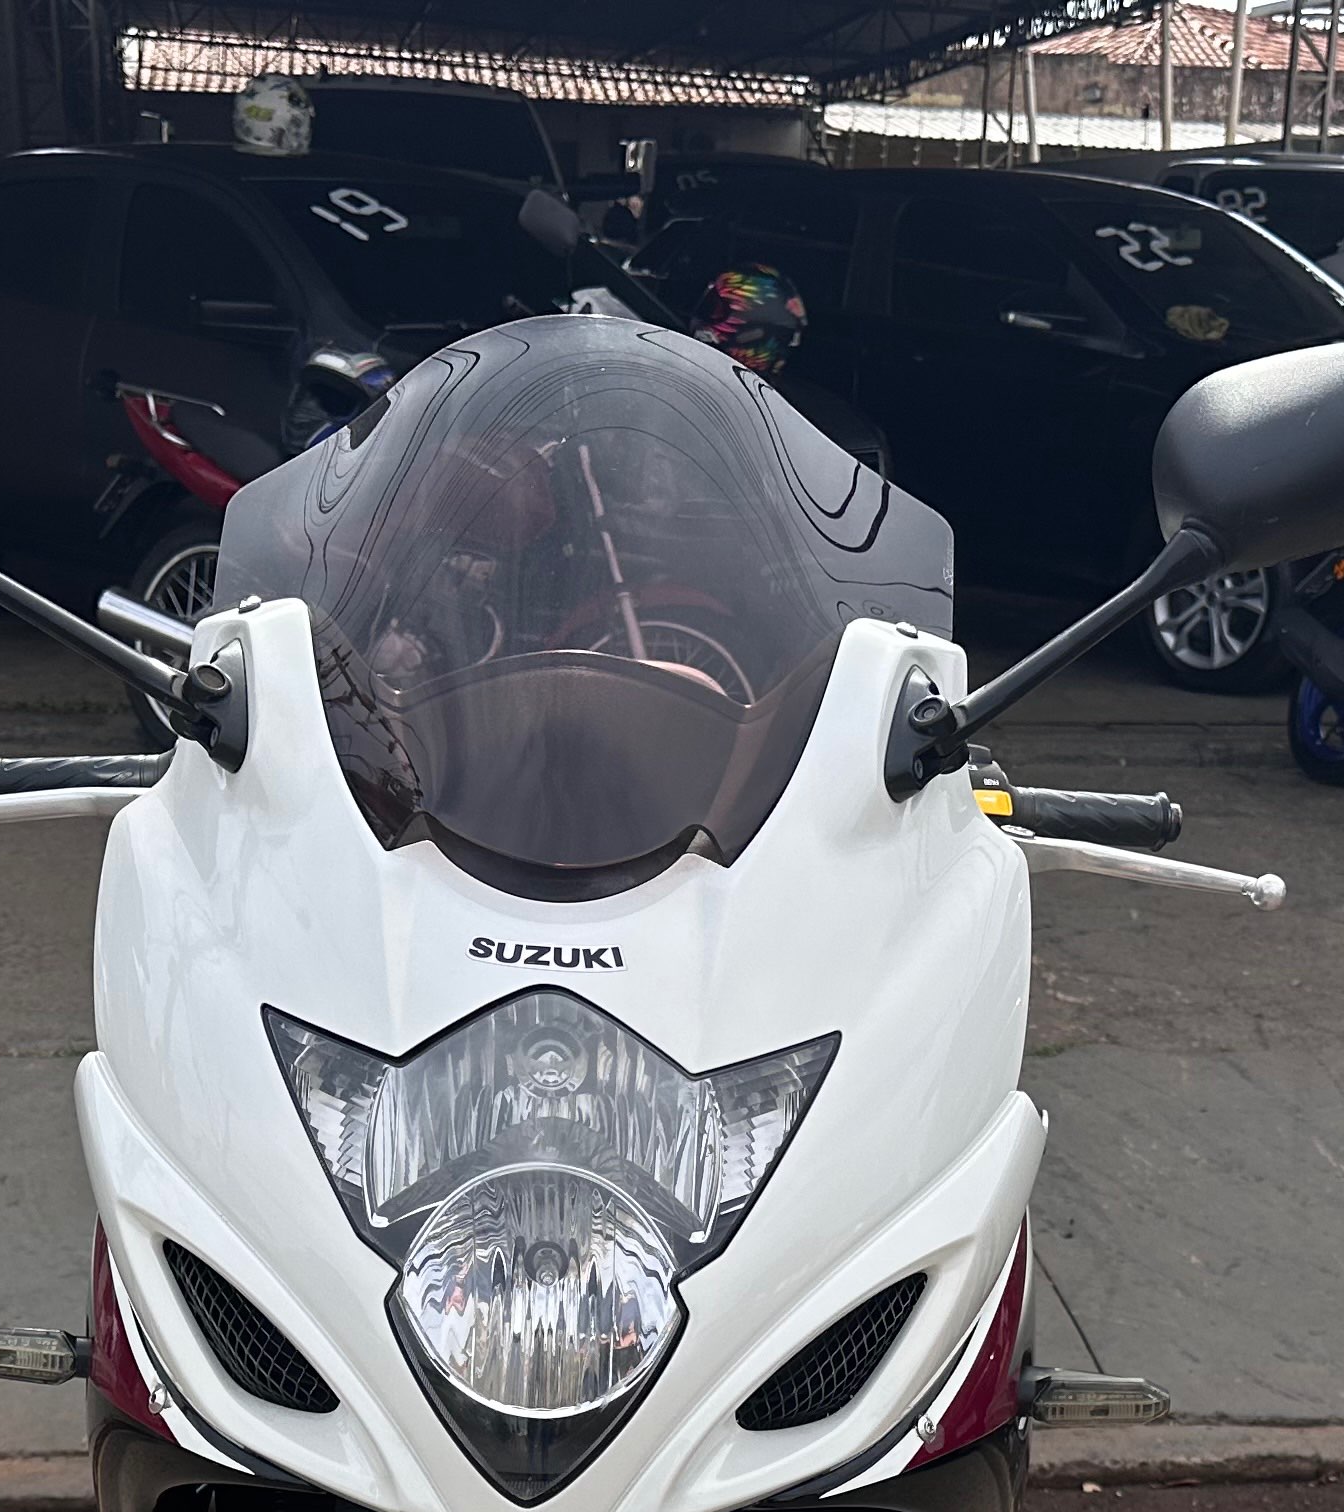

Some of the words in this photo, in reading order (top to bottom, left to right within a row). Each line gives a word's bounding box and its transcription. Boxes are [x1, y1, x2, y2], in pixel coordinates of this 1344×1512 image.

[310, 187, 408, 241] 19
[1095, 221, 1193, 271] 22
[468, 936, 624, 969] SUZUKI
